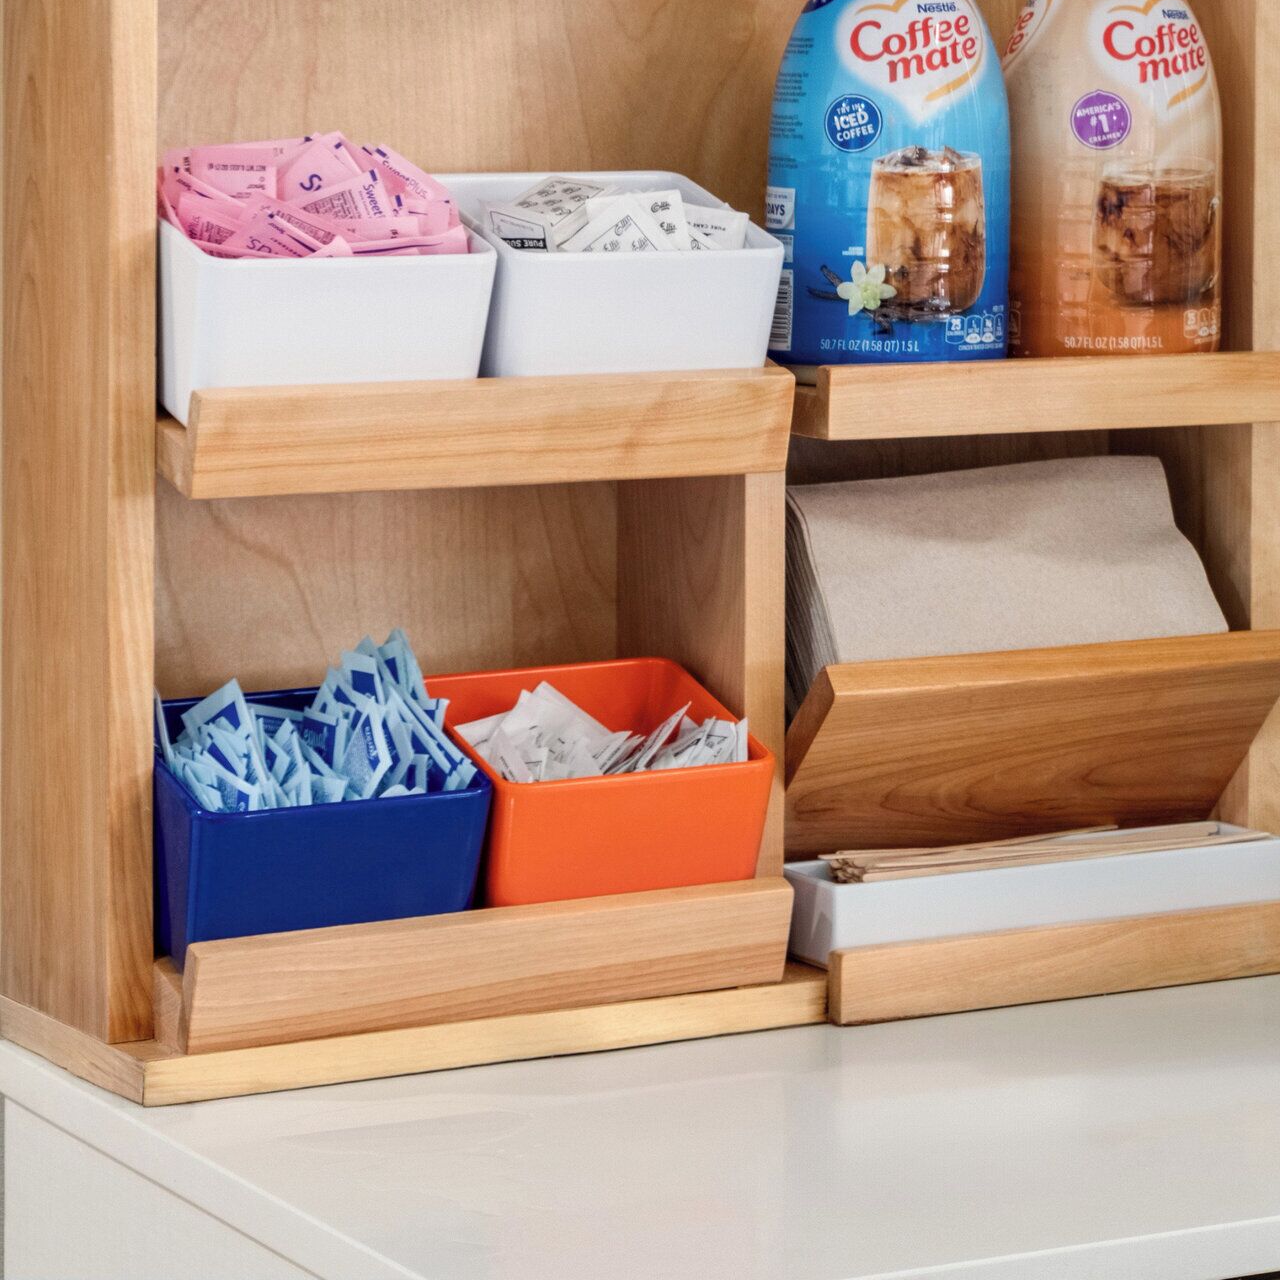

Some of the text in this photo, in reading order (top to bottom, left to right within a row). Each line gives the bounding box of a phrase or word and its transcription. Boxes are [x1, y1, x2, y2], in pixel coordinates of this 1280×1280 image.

[917, 1, 957, 14] Nestlé
[850, 14, 970, 62] Coffee
[1102, 19, 1200, 62] Coffee
[887, 36, 977, 84] mate
[1137, 45, 1206, 84] mate
[836, 103, 862, 115] TRY IN
[1076, 101, 1122, 118] AMERICA'S
[833, 108, 869, 131] ICED
[1089, 113, 1110, 134] #1
[836, 123, 875, 142] COFFEE
[522, 238, 545, 250] PURE
[820, 338, 920, 353] 50.7 FL OZ (1.58 QT) 1.5 L
[1063, 336, 1164, 350] 50.7 FL OZ (1.58 QT) 1.5 L
